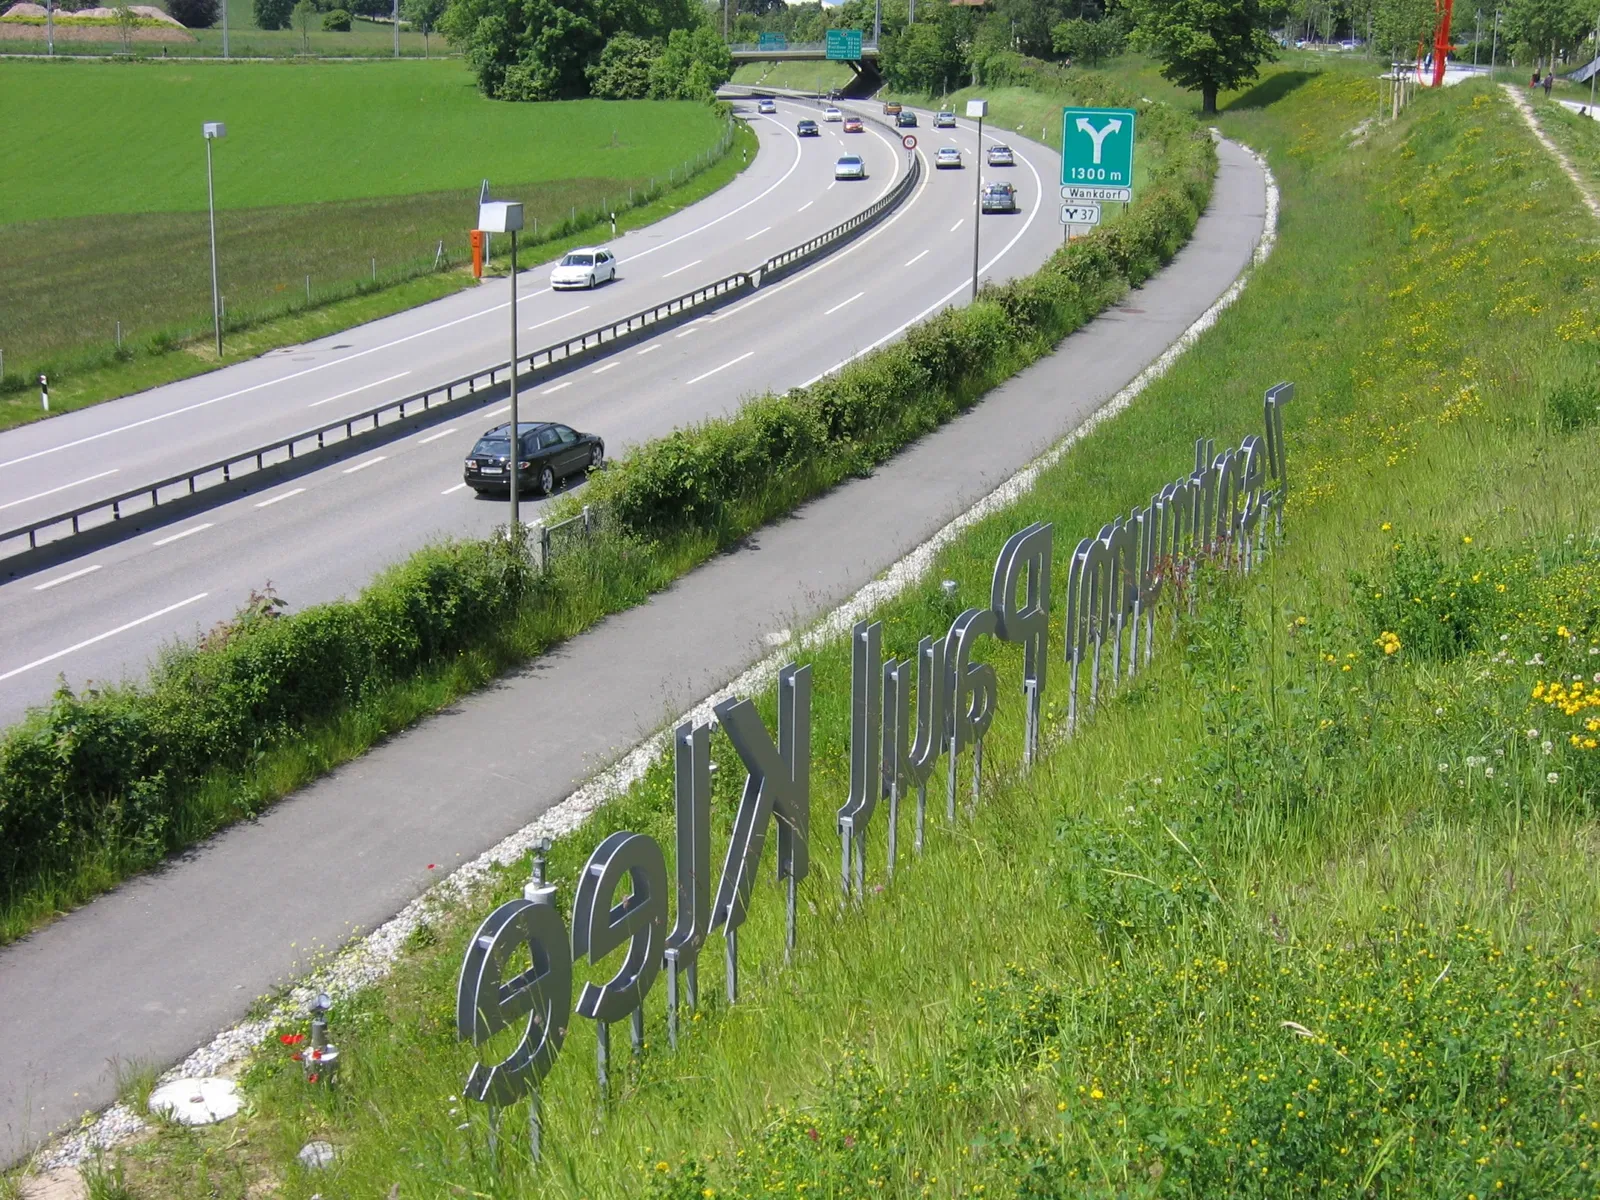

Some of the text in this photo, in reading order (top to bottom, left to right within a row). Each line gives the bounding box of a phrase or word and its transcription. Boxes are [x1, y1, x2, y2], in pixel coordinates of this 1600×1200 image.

[1071, 167, 1122, 181] 1300 m
[1070, 188, 1122, 199] Wankdorf
[1081, 209, 1094, 220] 37
